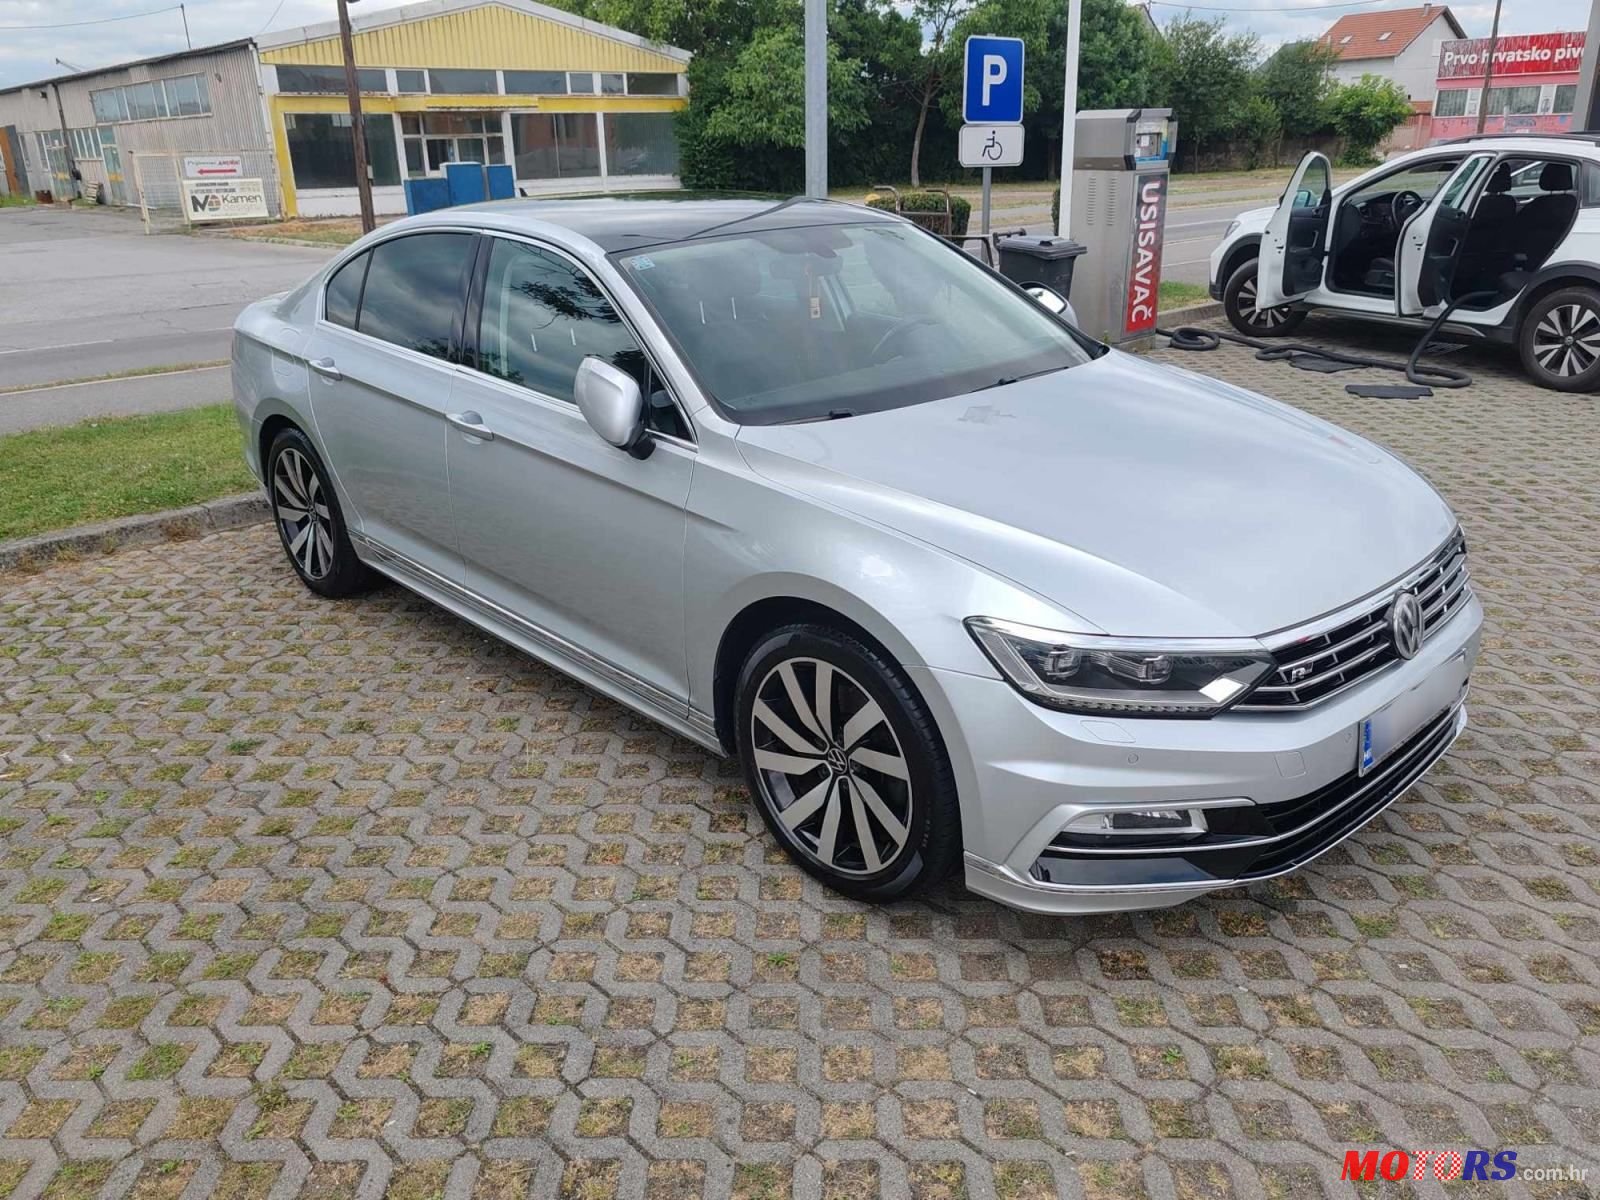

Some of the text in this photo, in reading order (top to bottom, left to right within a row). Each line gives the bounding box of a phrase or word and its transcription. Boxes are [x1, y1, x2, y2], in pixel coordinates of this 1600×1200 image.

[1444, 51, 1478, 66] Prvo
[1481, 47, 1551, 64] hrvatsko
[982, 54, 1008, 107] P
[222, 193, 263, 204] Kamen
[1131, 181, 1161, 323] USISAVAČ
